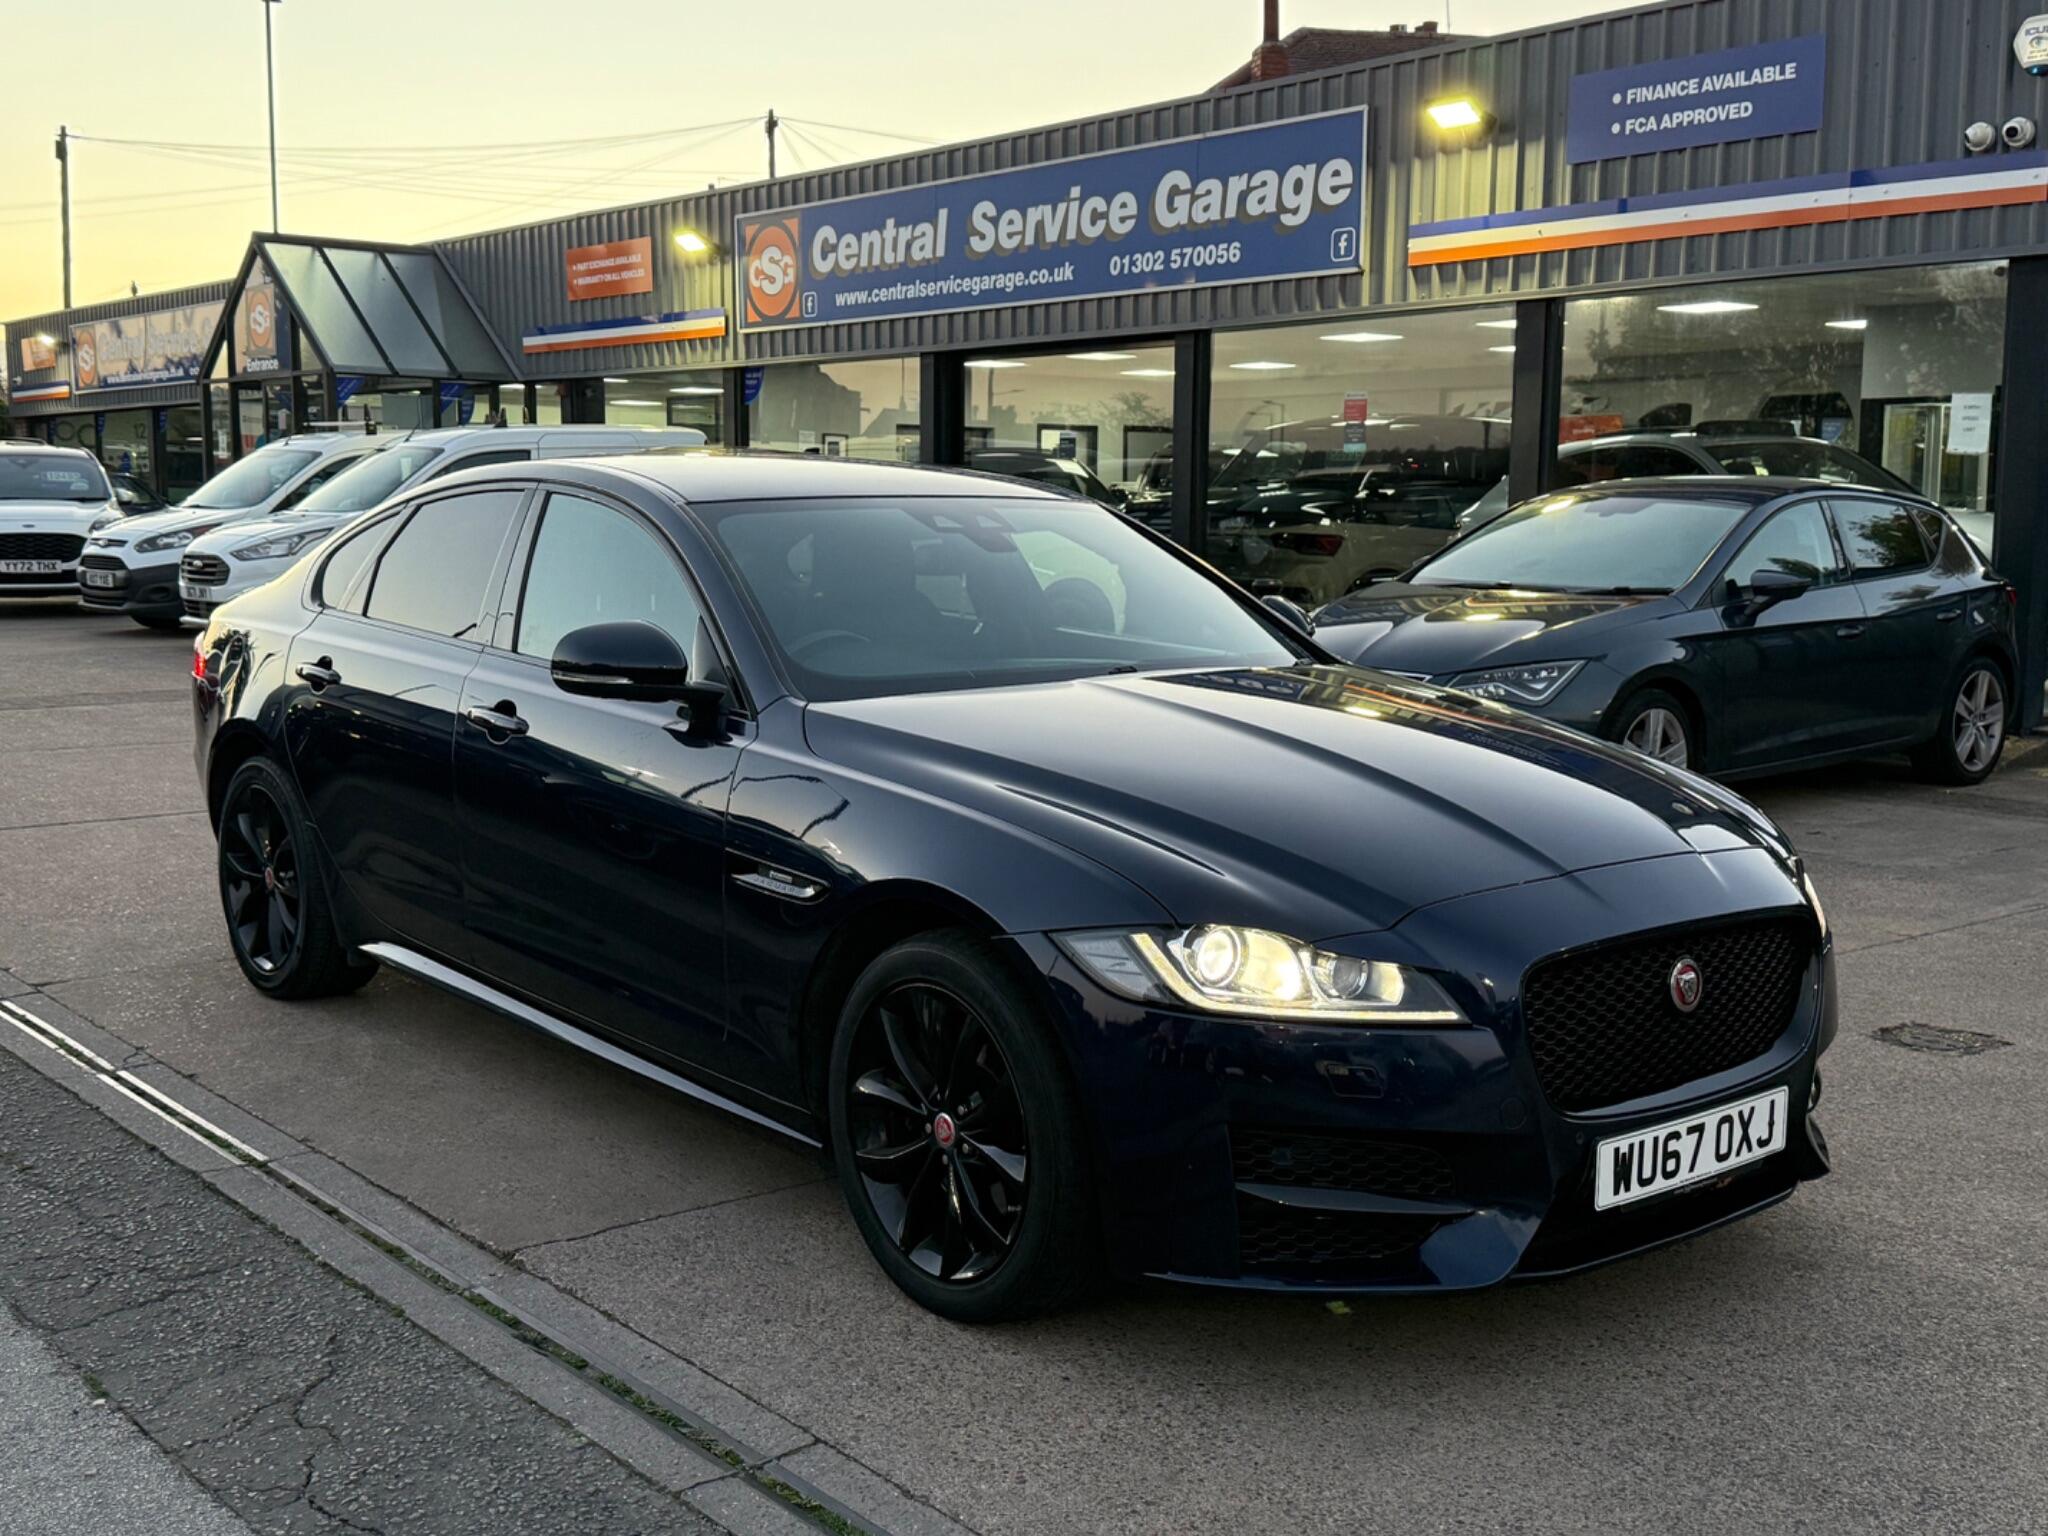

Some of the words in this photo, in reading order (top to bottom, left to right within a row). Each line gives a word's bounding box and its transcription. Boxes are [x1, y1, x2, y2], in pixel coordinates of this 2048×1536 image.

[1626, 78, 1700, 104] FINANCE
[1701, 63, 1797, 93] AVAILABLE
[1625, 115, 1657, 135] FCA
[1660, 101, 1753, 130] APPROVED
[811, 208, 949, 276] Central
[969, 185, 1138, 254] Service
[1154, 157, 1355, 229] Garage
[749, 246, 795, 295] CSG
[1109, 252, 1165, 276] 01302
[1169, 241, 1242, 270] 570056
[836, 262, 1075, 307] www.centralservicegarage.co.uk
[247, 356, 279, 372] Entrance
[4, 560, 33, 571] YY72
[37, 560, 57, 571] THX
[1612, 1122, 1706, 1197] WU67
[1714, 1099, 1776, 1163] OXJ
